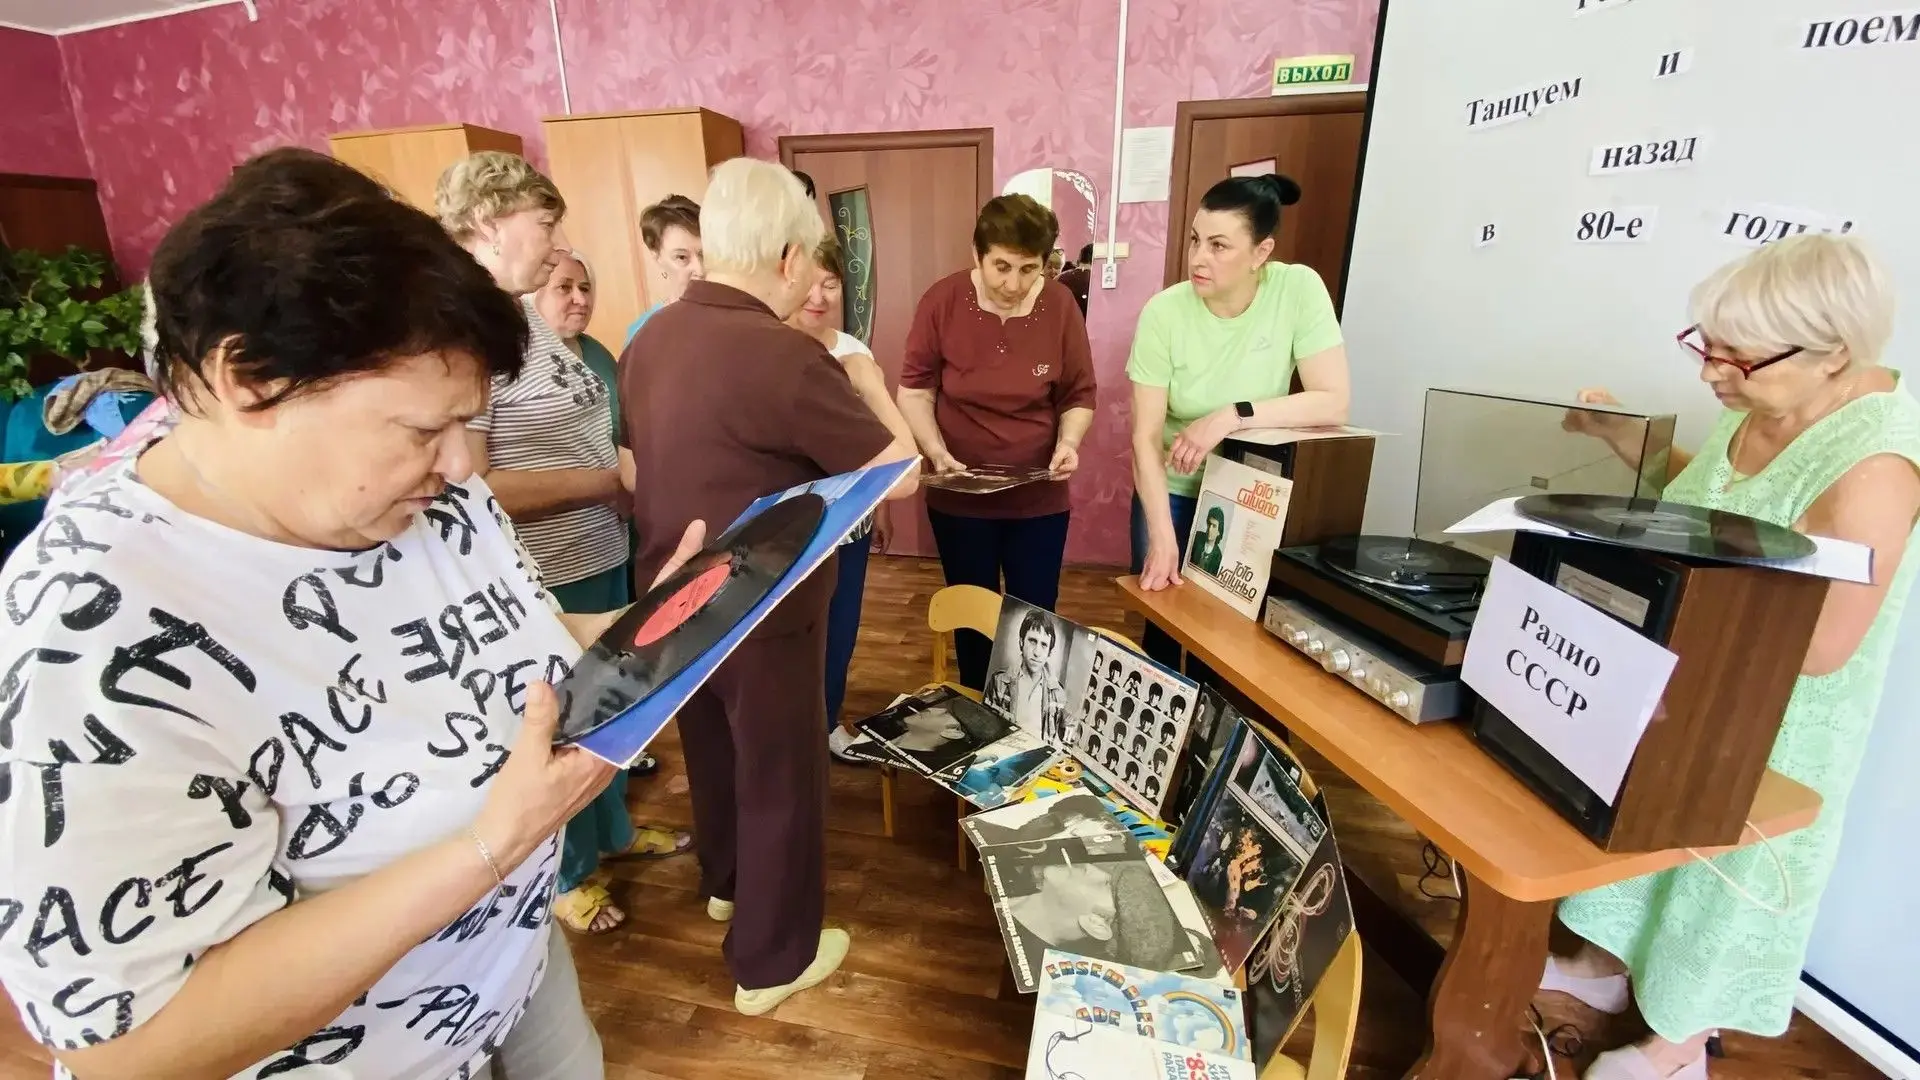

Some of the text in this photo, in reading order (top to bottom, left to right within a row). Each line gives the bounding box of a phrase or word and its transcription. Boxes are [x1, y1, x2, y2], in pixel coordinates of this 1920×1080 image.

[1279, 64, 1346, 84] ВЫХОД
[1466, 13, 1920, 127] Танцуем и поем
[1601, 136, 1697, 168] назад
[1481, 210, 1853, 245] в 80-е год
[1520, 605, 1601, 677] Радио
[1506, 649, 1588, 719] СССР
